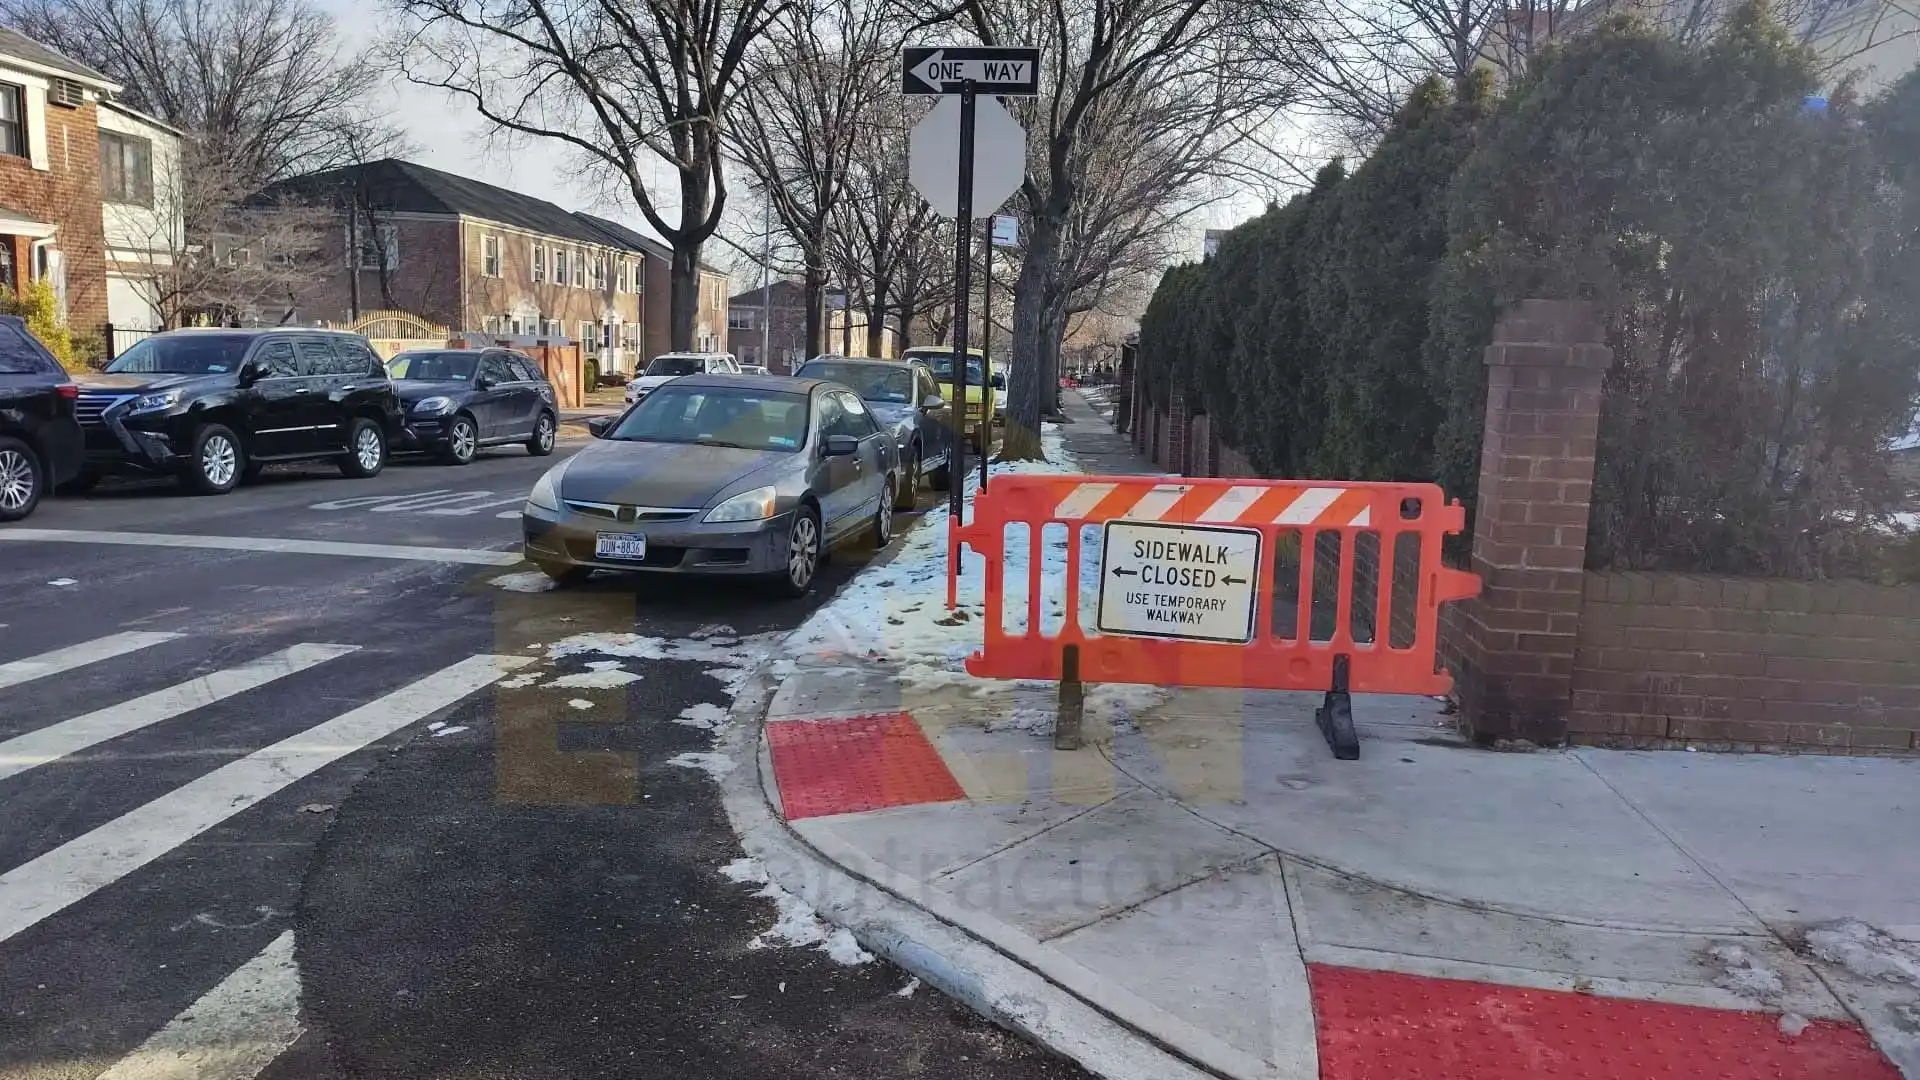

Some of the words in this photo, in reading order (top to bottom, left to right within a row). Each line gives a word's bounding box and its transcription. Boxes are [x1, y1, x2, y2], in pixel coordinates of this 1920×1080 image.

[928, 62, 964, 80] ONE
[984, 62, 1024, 81] WAY
[1134, 540, 1229, 565] SIDEWALK
[1142, 565, 1216, 588] CLOSED
[1126, 592, 1150, 605] USE
[1154, 594, 1227, 612] TEMPORARY
[1147, 609, 1204, 625] WALKWAY
